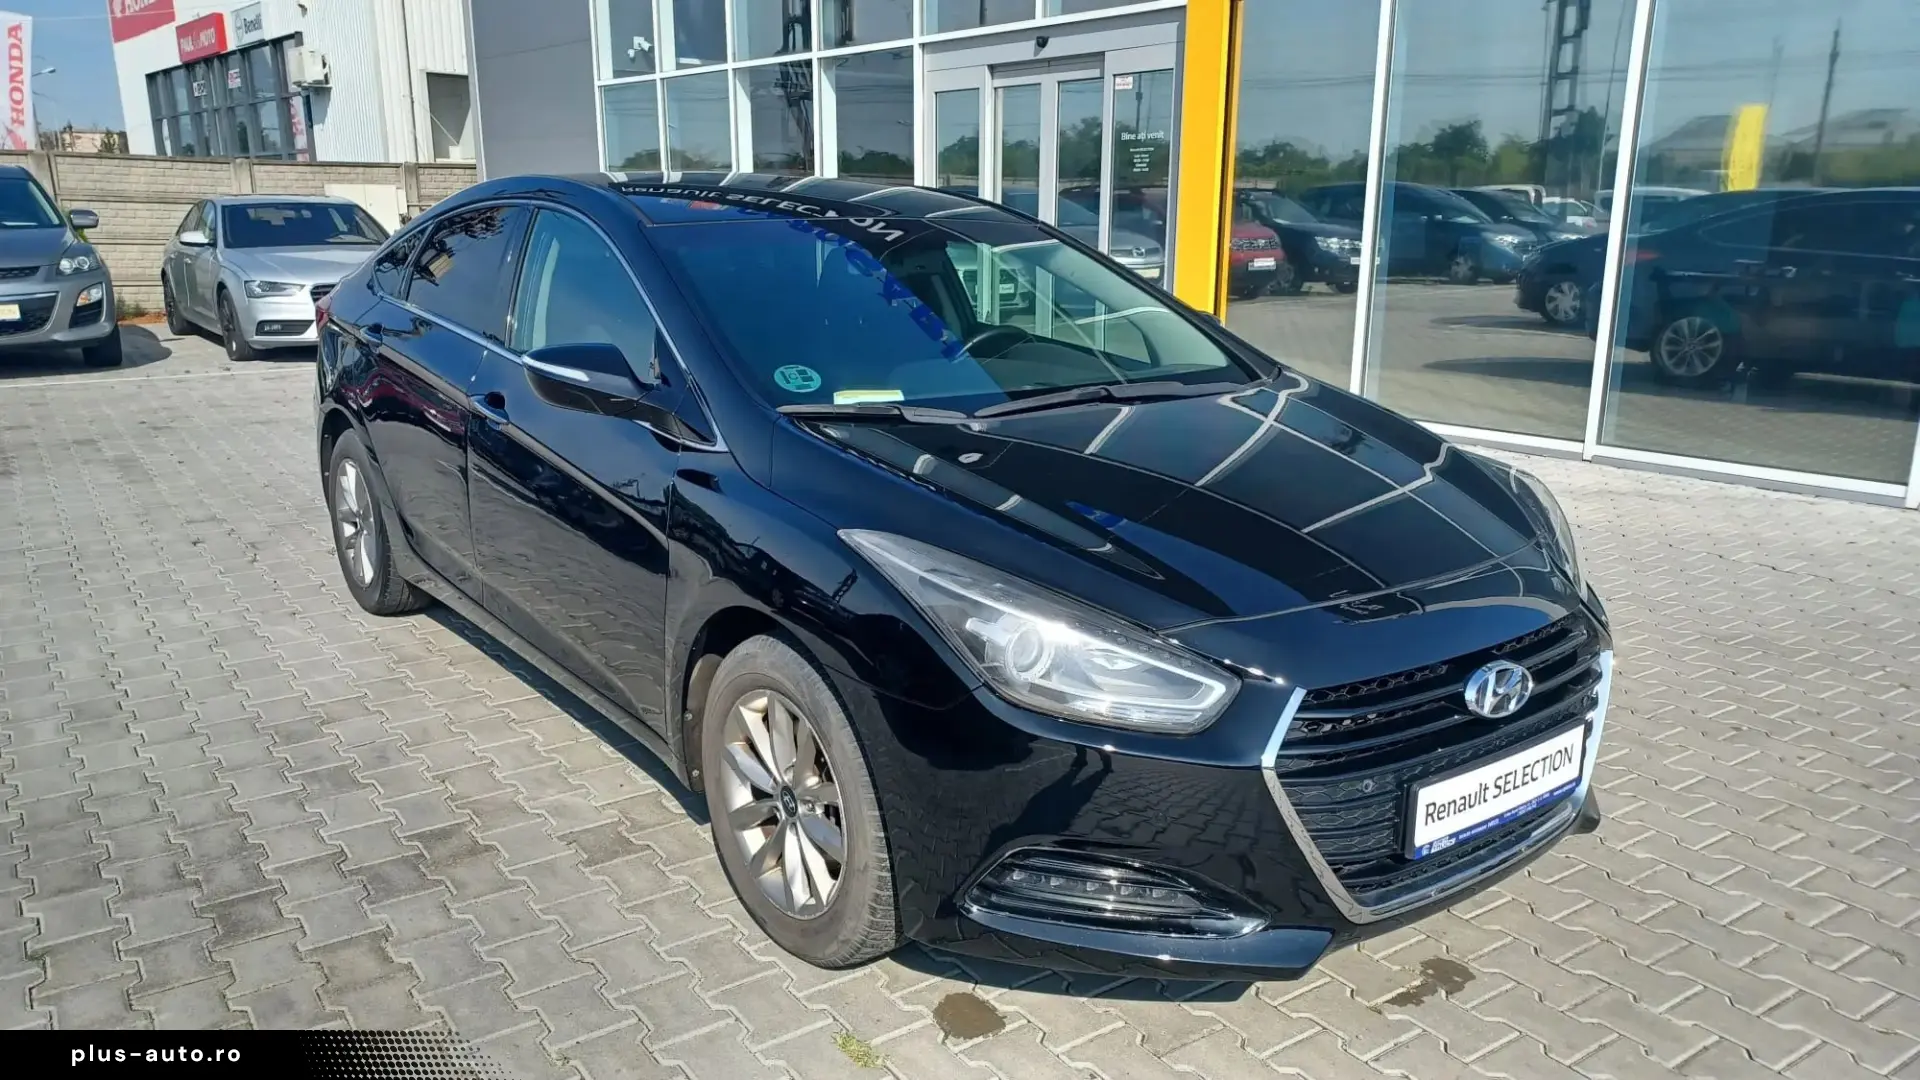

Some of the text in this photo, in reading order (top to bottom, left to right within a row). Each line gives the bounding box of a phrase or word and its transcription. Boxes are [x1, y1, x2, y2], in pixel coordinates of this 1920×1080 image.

[8, 23, 24, 126] HONDA
[1121, 132, 1136, 140] Bine
[1147, 130, 1164, 139] venit
[1425, 783, 1489, 826] Renault
[1492, 743, 1575, 800] SELECTION
